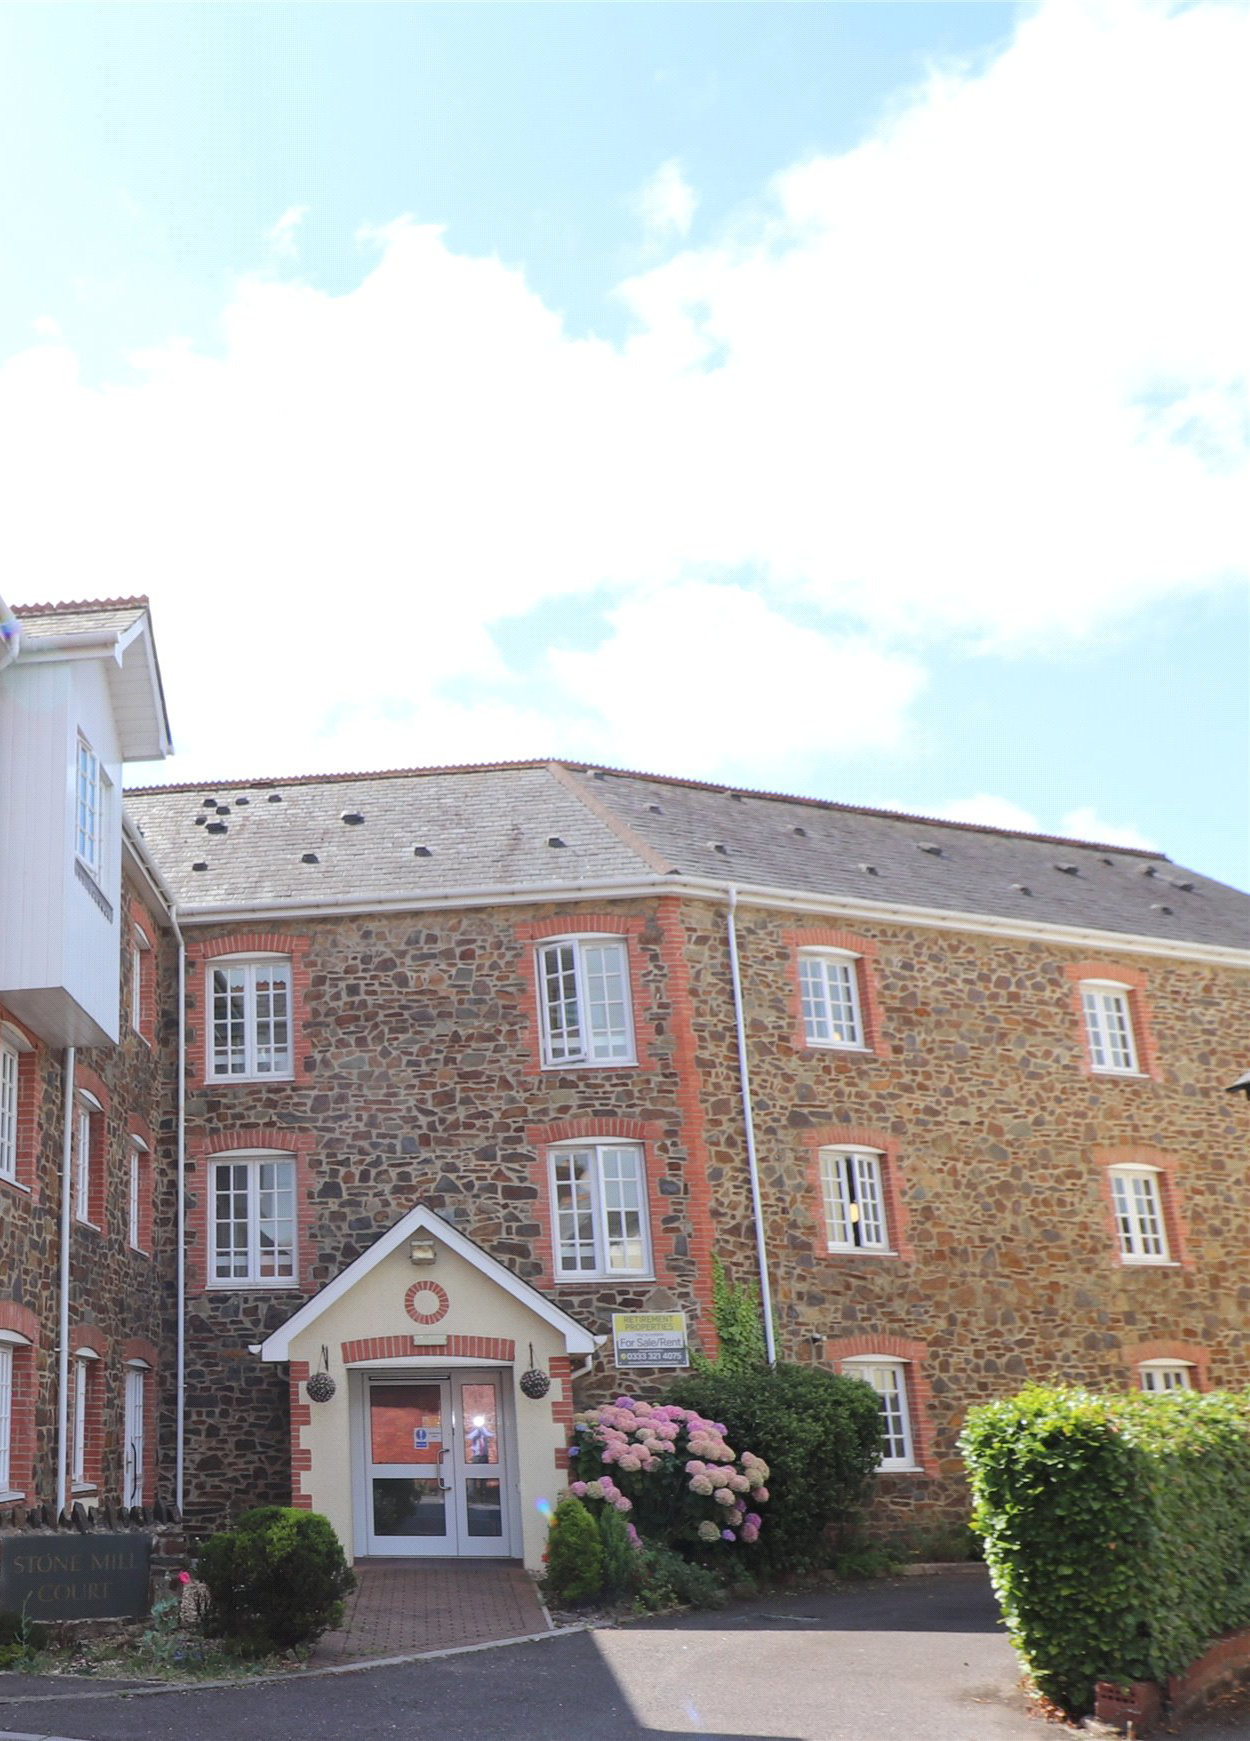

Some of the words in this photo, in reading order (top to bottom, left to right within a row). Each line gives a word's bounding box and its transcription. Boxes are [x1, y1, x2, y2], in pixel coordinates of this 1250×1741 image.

[623, 1315, 674, 1323] RETIREMENT
[625, 1323, 674, 1331] PROPERTIES
[620, 1338, 634, 1347] For
[637, 1337, 682, 1347] Sale/Rent
[627, 1352, 647, 1360] 0333
[662, 1351, 682, 1360] 4075
[13, 1553, 81, 1575] STONE
[91, 1552, 139, 1572] MILL
[37, 1582, 112, 1602] COURT
